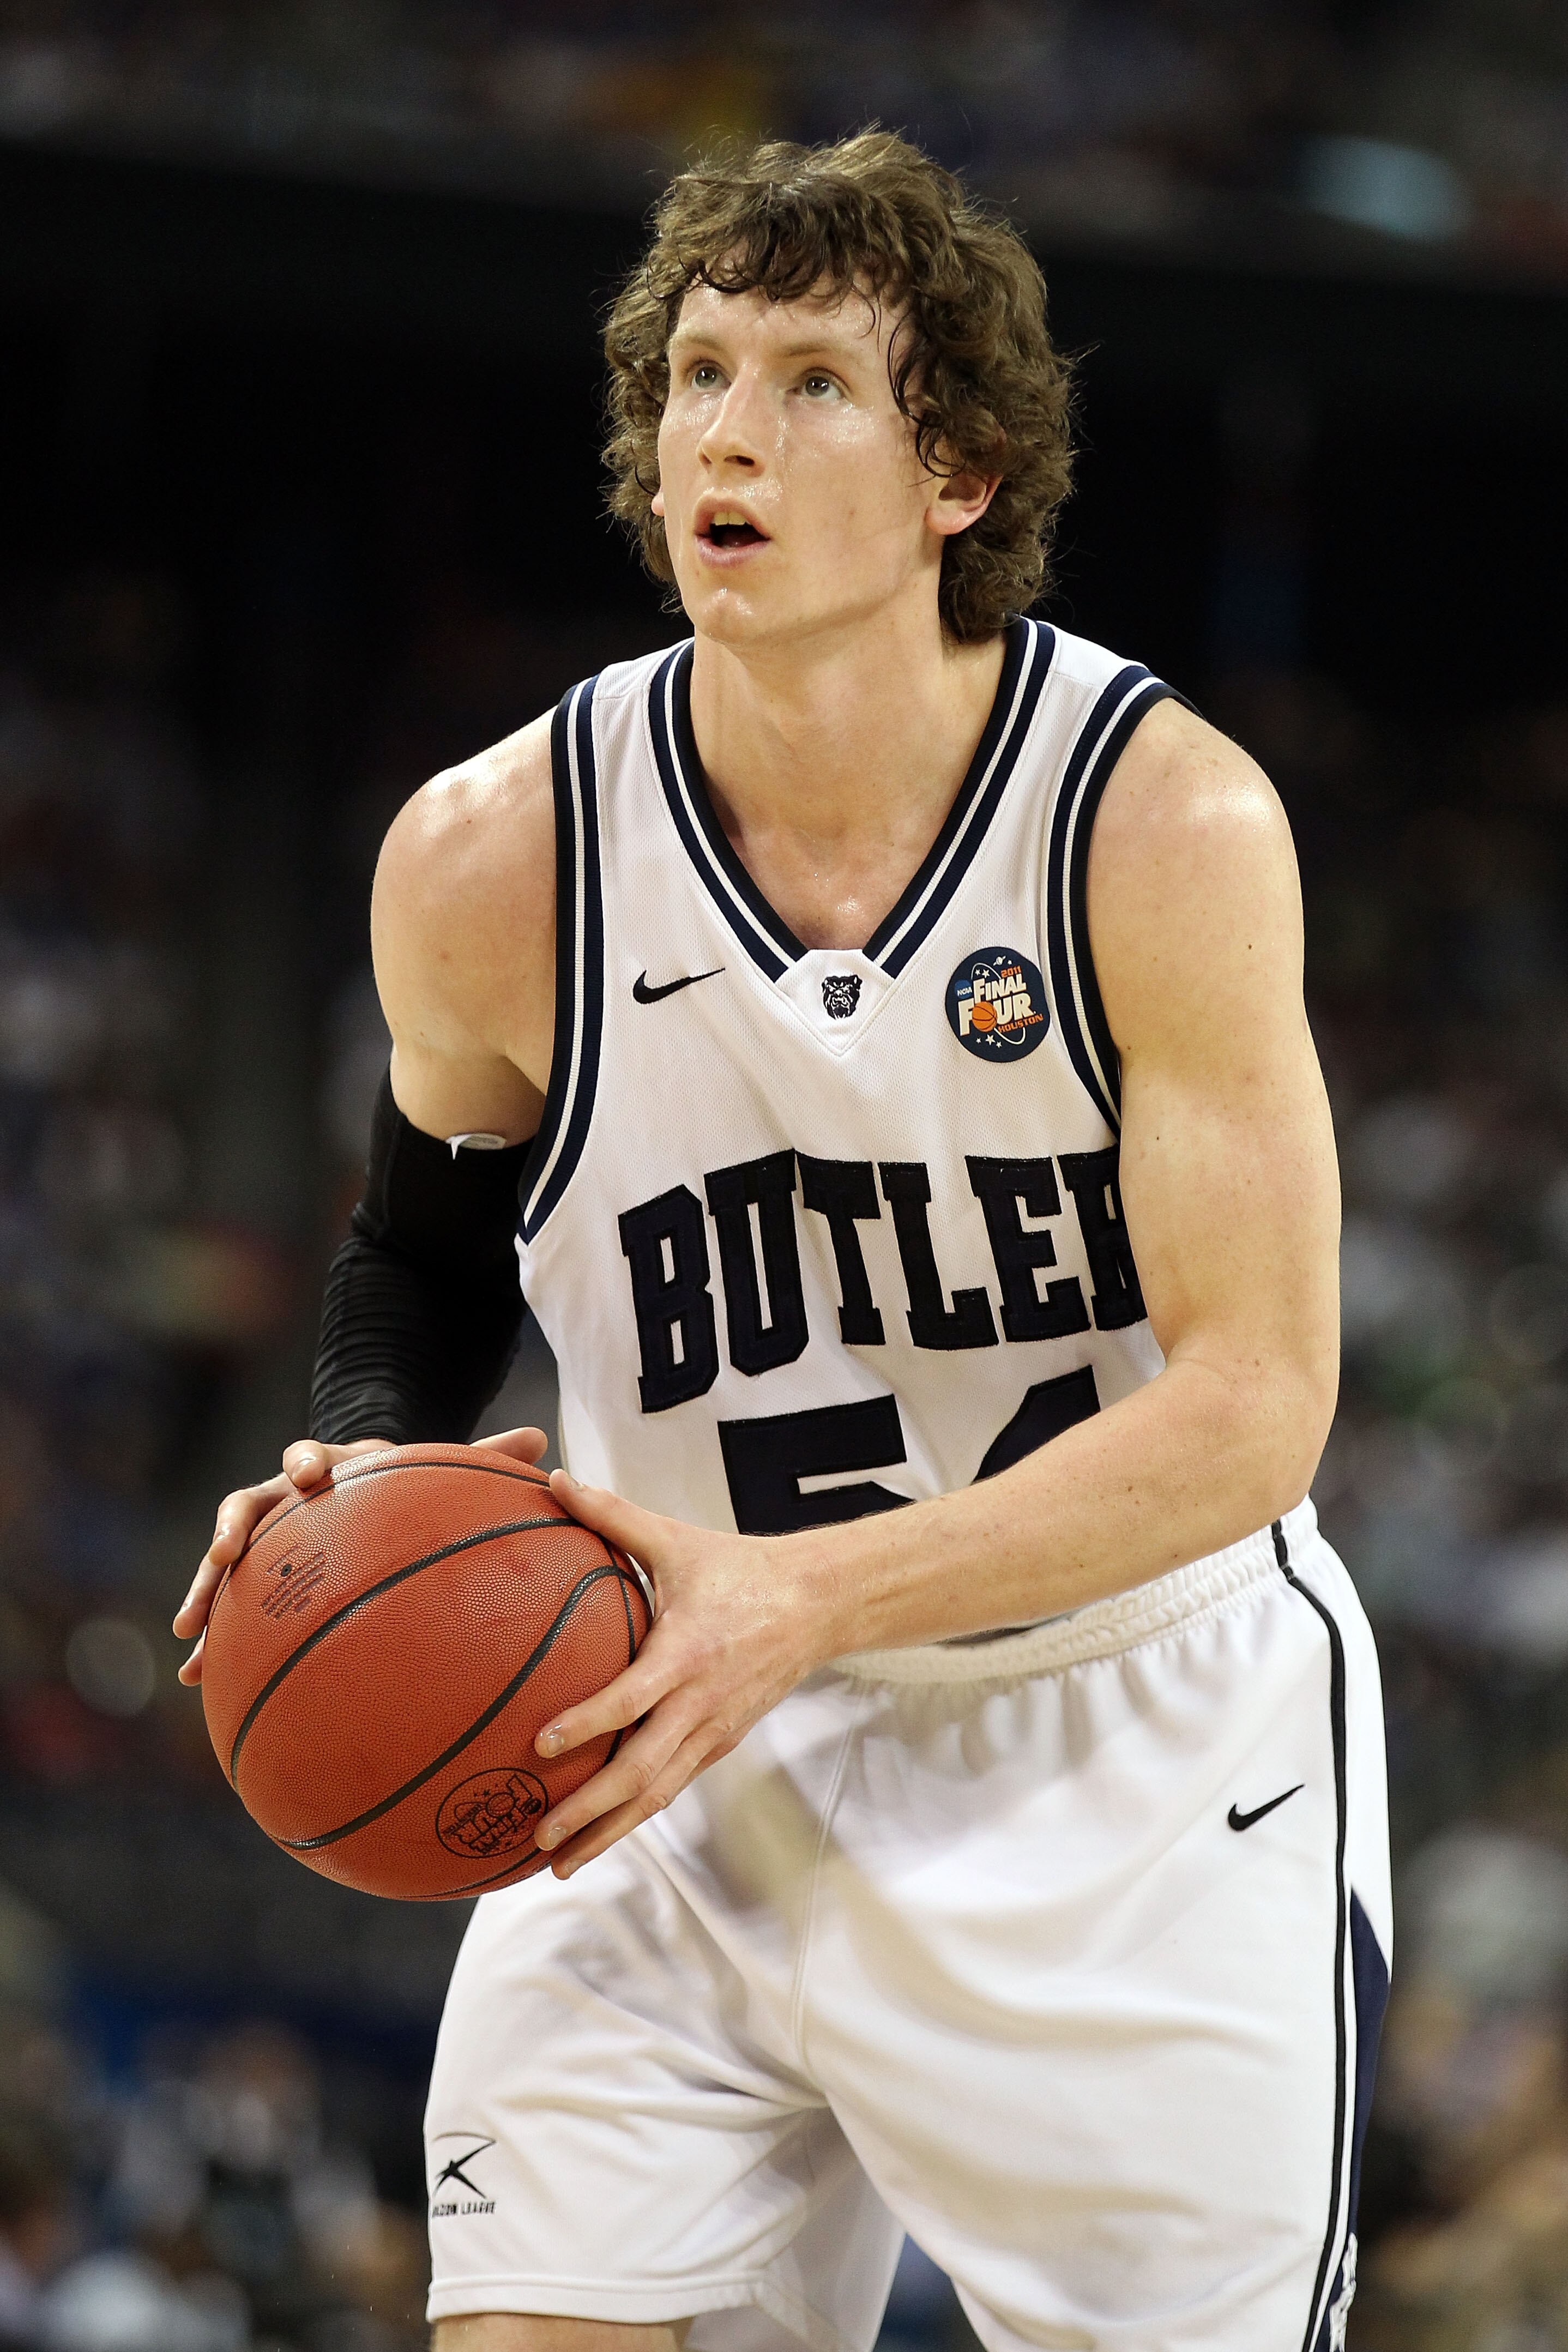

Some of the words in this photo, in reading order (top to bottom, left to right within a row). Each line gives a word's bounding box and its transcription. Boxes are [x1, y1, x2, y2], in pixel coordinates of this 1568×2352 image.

[1000, 965, 1021, 978] 2011
[957, 986, 972, 996] NCAA
[973, 973, 1027, 1004] FINAL
[958, 992, 1034, 1036] FOUR
[997, 1014, 1044, 1033] HOUSTON
[618, 1148, 1149, 1414] BUTLER
[468, 1805, 527, 1852] FINAL
